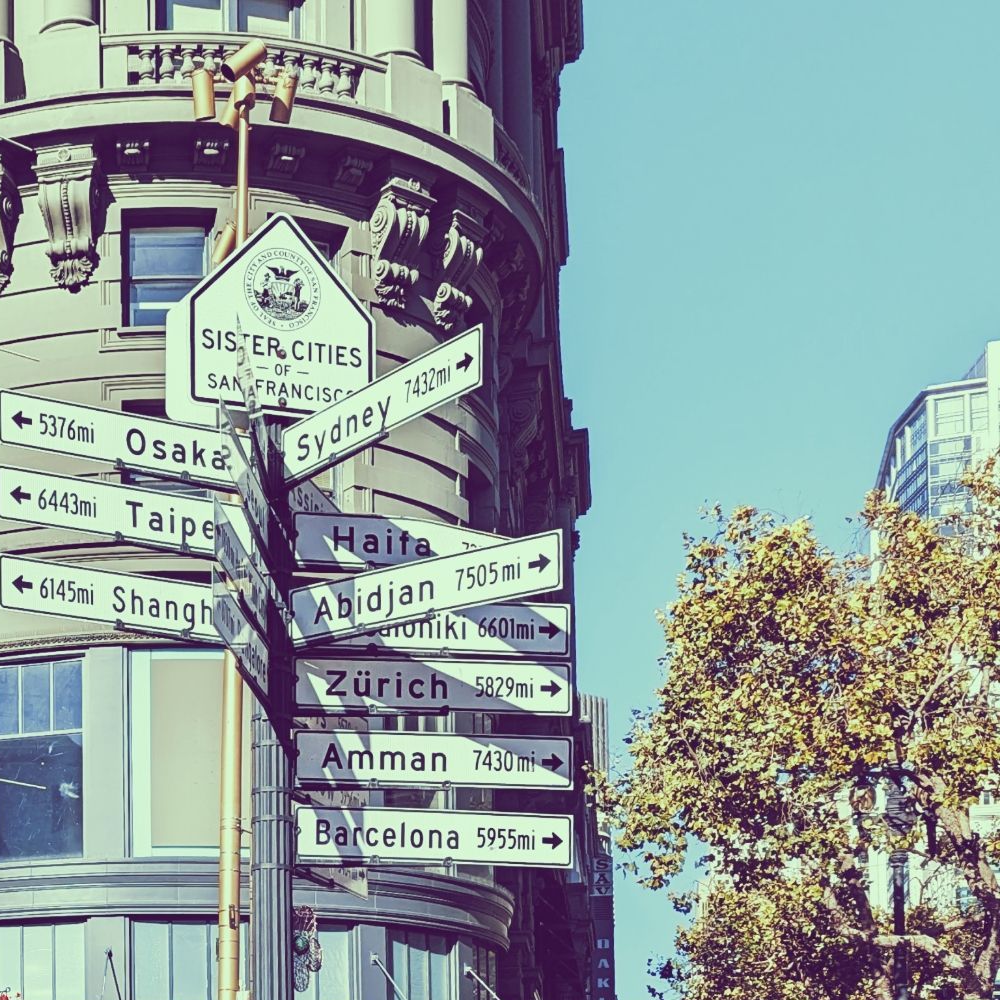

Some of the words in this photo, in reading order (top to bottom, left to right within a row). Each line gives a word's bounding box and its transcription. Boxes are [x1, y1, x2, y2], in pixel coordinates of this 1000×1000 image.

[246, 263, 258, 280] CITY
[257, 251, 272, 262] AND
[273, 250, 304, 266] COUNTY
[288, 295, 319, 328] FRANCISCO
[201, 328, 281, 358] SISTER
[291, 340, 362, 368] CITIES
[207, 372, 242, 392] SAN
[274, 363, 291, 377] OF
[296, 396, 391, 462] Sydney
[404, 358, 451, 404] 7432mi
[38, 412, 95, 444] 5376mi
[125, 427, 226, 471] Osaka
[37, 488, 97, 519] 6443mi
[125, 499, 214, 545] Taipe
[332, 525, 432, 558] Haifa
[39, 576, 94, 606] 6145mi
[112, 585, 213, 631] Shangh
[313, 578, 435, 625] Abidjan
[477, 617, 535, 641] 6601mi
[325, 669, 449, 701] Zürich
[474, 675, 534, 700] 5829mi
[321, 742, 448, 773] Amman
[315, 818, 460, 850] Barcelona
[477, 826, 536, 851] 5955mi
